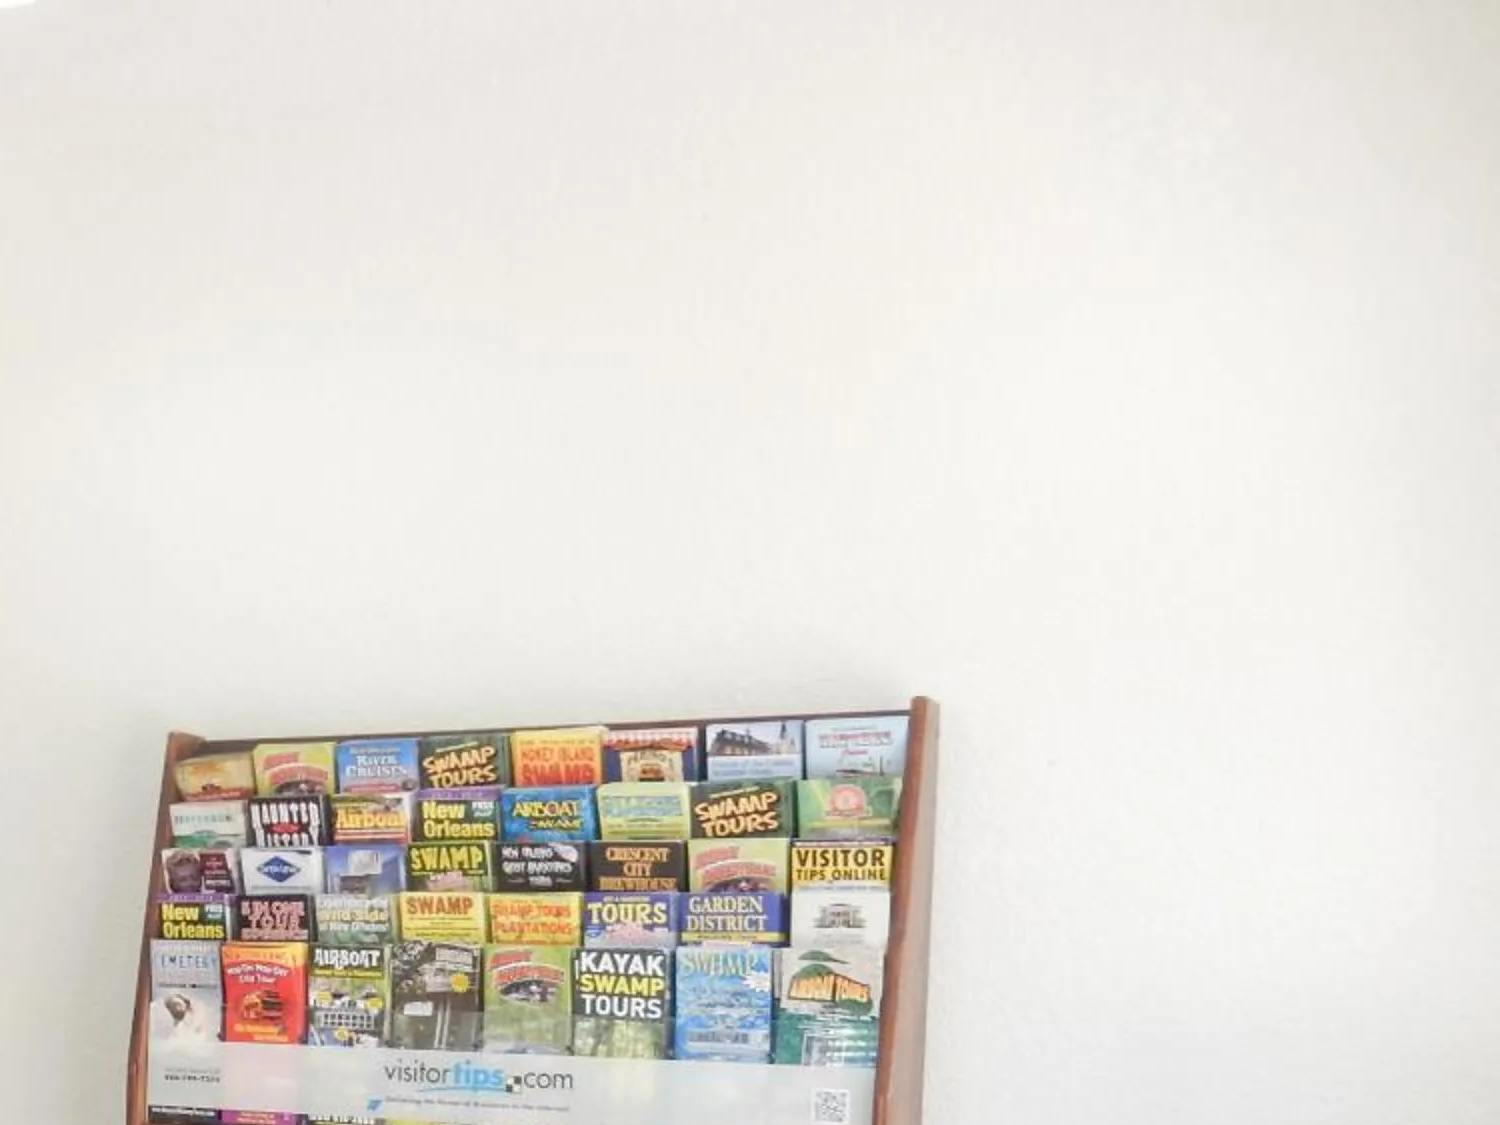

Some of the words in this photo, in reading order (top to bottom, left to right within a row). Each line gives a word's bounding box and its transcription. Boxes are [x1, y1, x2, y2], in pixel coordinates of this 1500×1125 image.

[422, 745, 496, 775] SWAMP
[428, 765, 497, 788] TOURS
[250, 801, 321, 831] HAUNTED
[421, 802, 466, 819] New
[694, 791, 778, 821] SWAMP
[422, 819, 495, 840] Orleans
[702, 811, 778, 838] TOURS
[410, 845, 484, 871] SWAMP
[604, 846, 671, 863] CRESCENT
[795, 849, 886, 868] VISITOR
[623, 861, 652, 877] CITY
[796, 868, 826, 881] TIPS
[831, 868, 887, 881] ONLINE
[161, 904, 199, 921] New
[407, 897, 473, 916] SWAMP
[587, 902, 668, 925] TOURS
[689, 895, 764, 914] GARDEN
[162, 921, 225, 940] Orleans
[685, 915, 768, 932] DISTRICT
[314, 948, 381, 968] AIRBOAT
[580, 951, 665, 976] KAYAK
[578, 973, 665, 997] SWAMP
[580, 994, 663, 1019] TOURS
